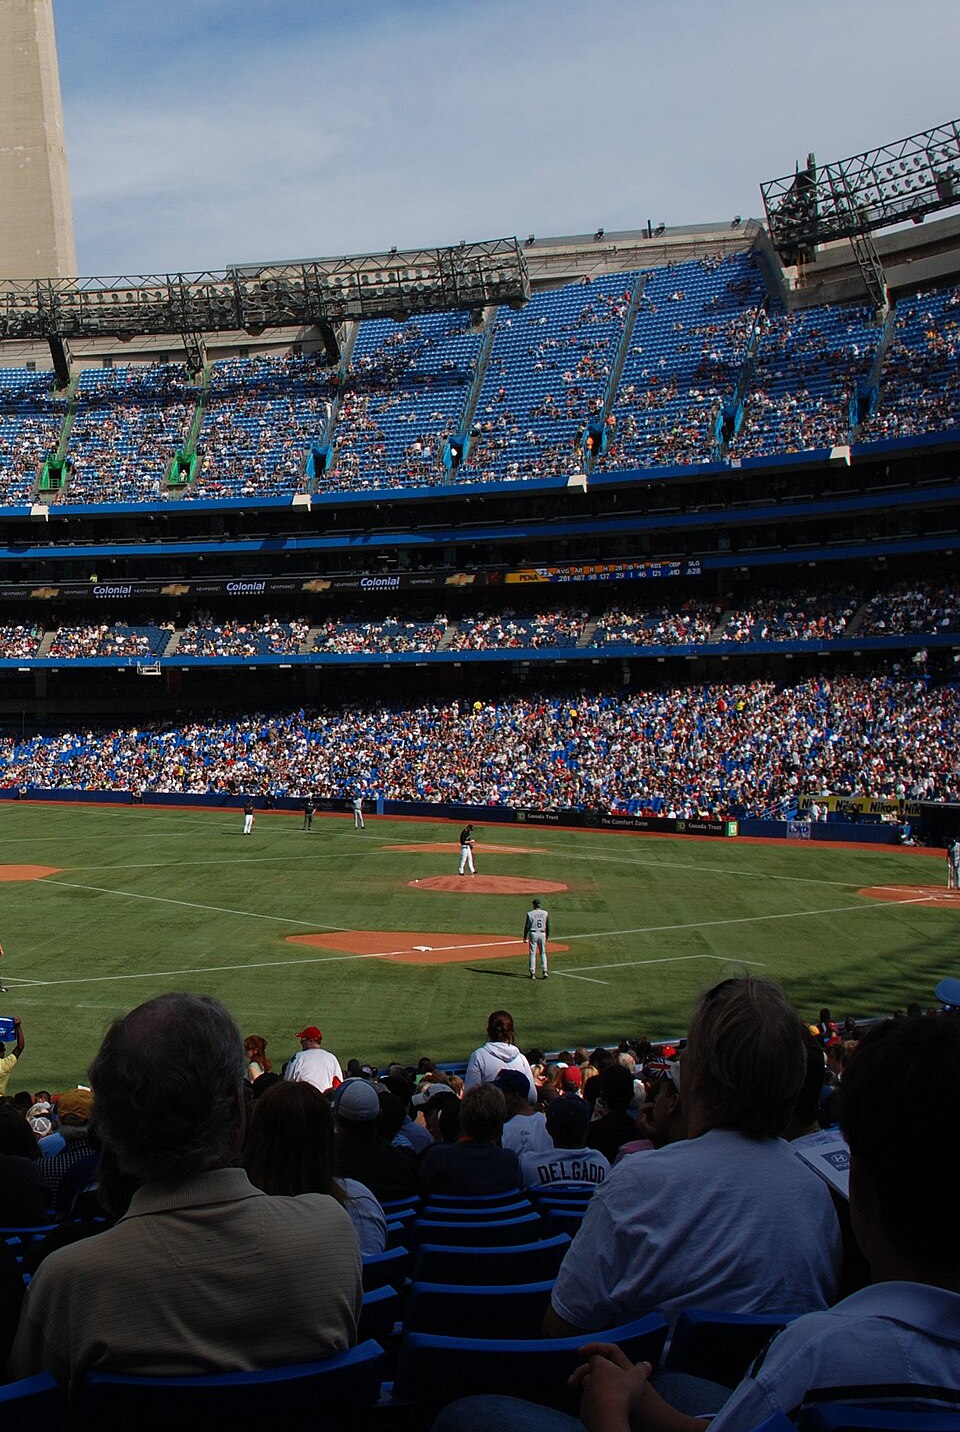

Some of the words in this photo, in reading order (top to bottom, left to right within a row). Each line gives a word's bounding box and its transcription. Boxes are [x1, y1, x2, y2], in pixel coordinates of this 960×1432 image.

[361, 577, 400, 586] Colonial
[519, 574, 538, 582] PENA
[93, 585, 132, 595] Colonial
[226, 582, 266, 592] Colonial
[870, 802, 899, 812] Nikon
[537, 919, 542, 928] 6
[537, 1161, 605, 1184] DELGADO
